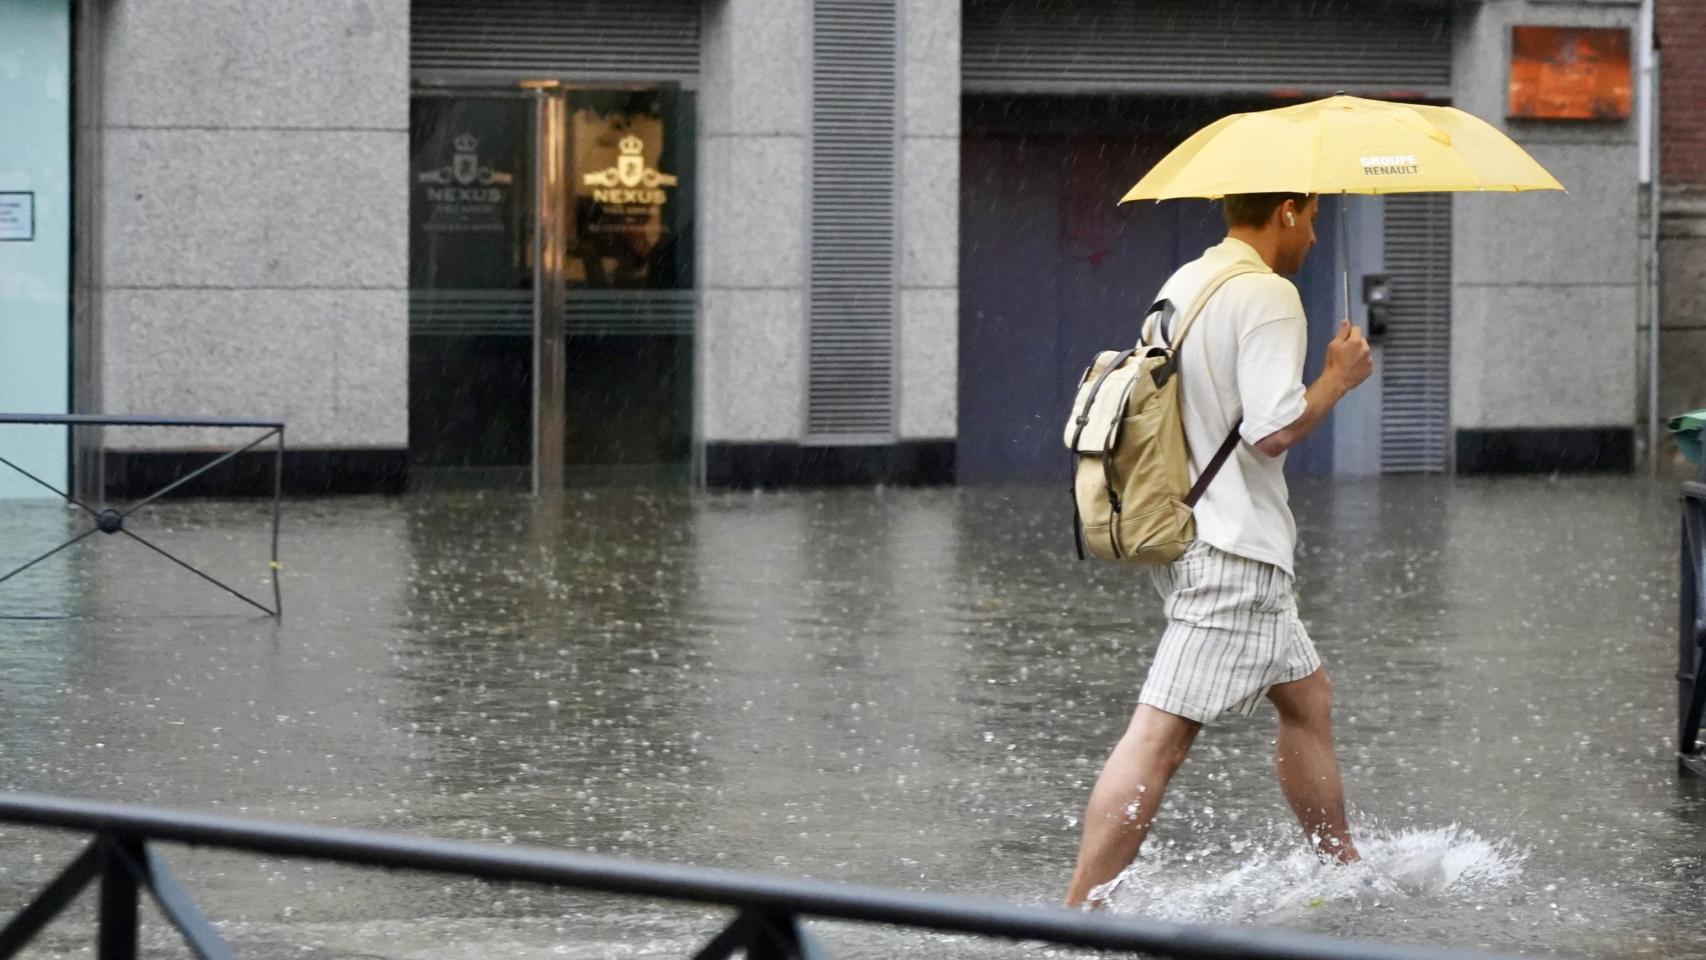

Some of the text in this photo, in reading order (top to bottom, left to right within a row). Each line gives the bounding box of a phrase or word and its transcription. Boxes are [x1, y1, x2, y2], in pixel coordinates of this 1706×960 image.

[1360, 154, 1417, 167] GROUPE
[1363, 165, 1419, 176] RENAULT
[426, 187, 501, 203] NEXUS
[593, 188, 667, 205] NEXUS
